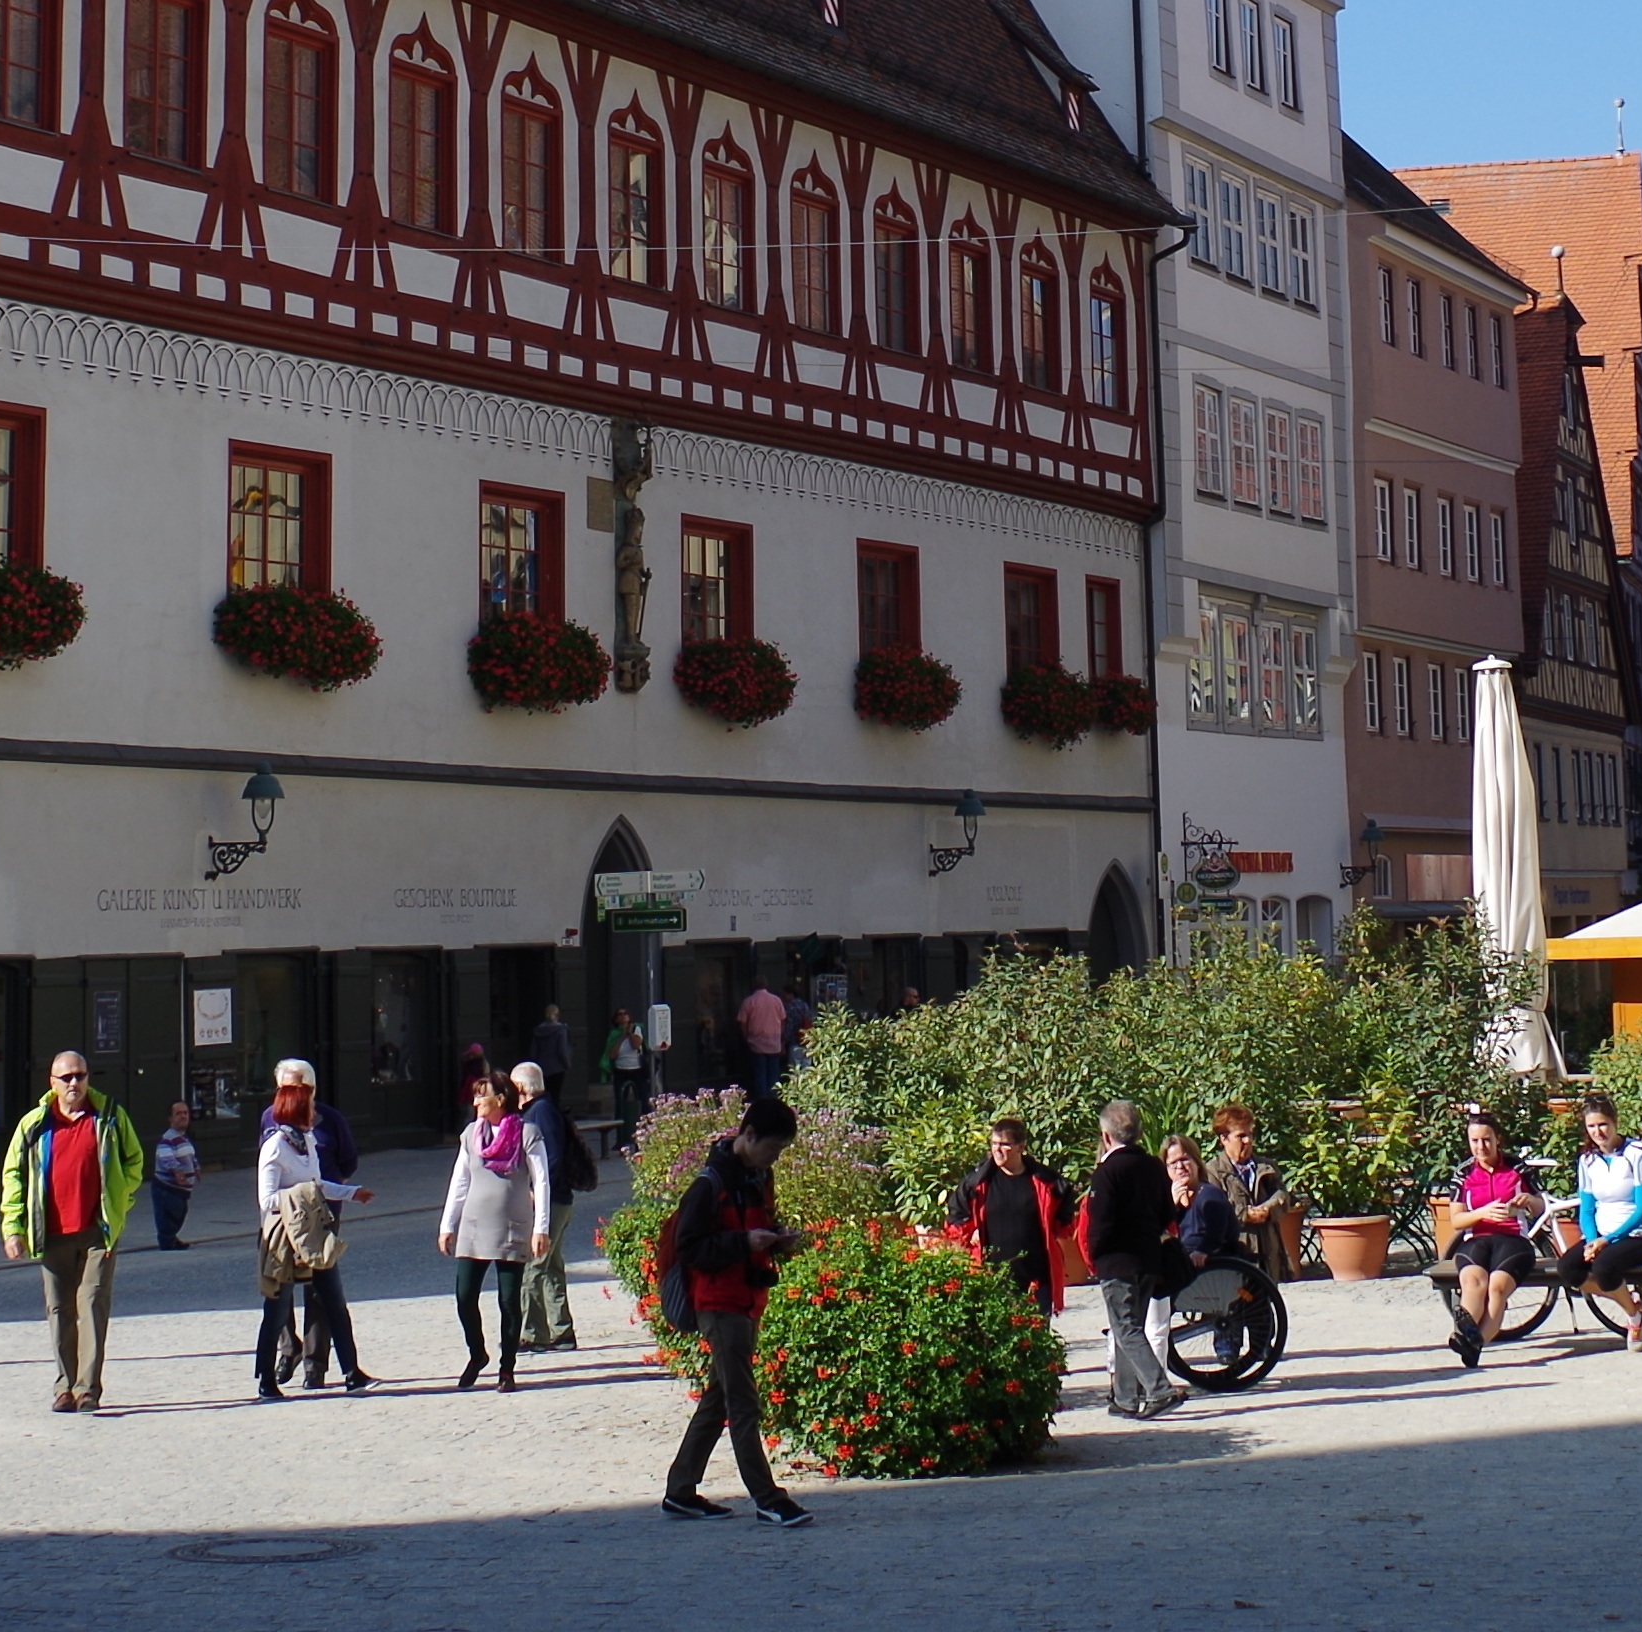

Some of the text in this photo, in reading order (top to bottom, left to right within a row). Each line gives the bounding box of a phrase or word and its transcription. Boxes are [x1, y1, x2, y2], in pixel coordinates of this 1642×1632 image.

[96, 887, 303, 912] GALERIE KUNST U HANDWERK
[394, 888, 518, 908] GESCHENK BOUTIQUE
[762, 887, 814, 907] GESCHENKE
[628, 916, 670, 926] Information
